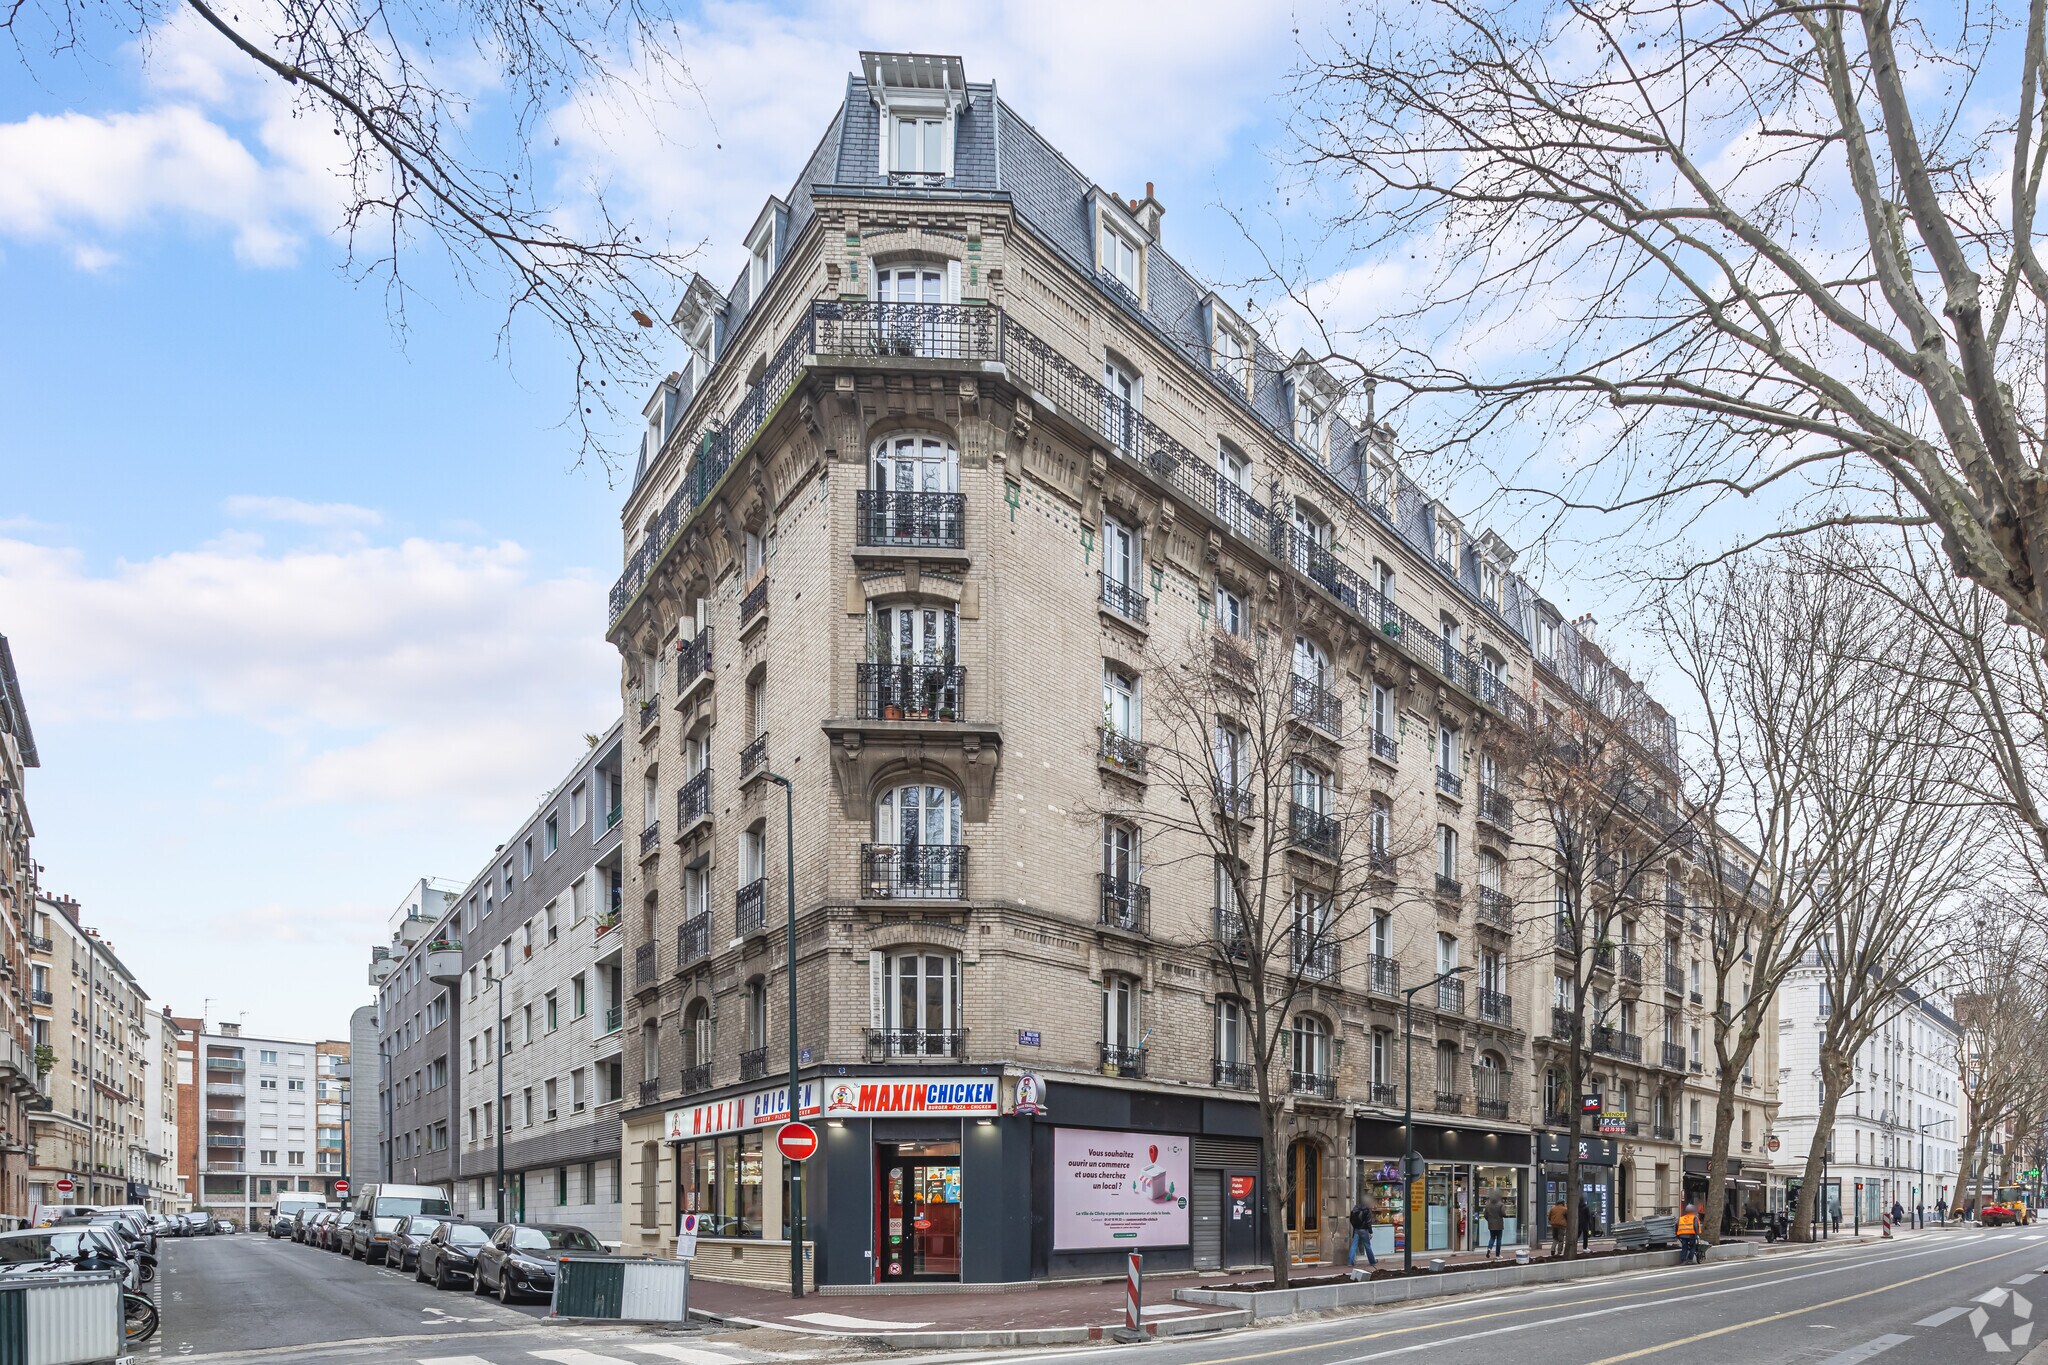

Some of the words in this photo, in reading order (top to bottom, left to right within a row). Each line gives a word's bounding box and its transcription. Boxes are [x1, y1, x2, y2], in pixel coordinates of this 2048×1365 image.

[692, 1099, 745, 1135] MAXIN
[1104, 1150, 1134, 1158] souhaitez
[1099, 1171, 1126, 1179] cherchez
